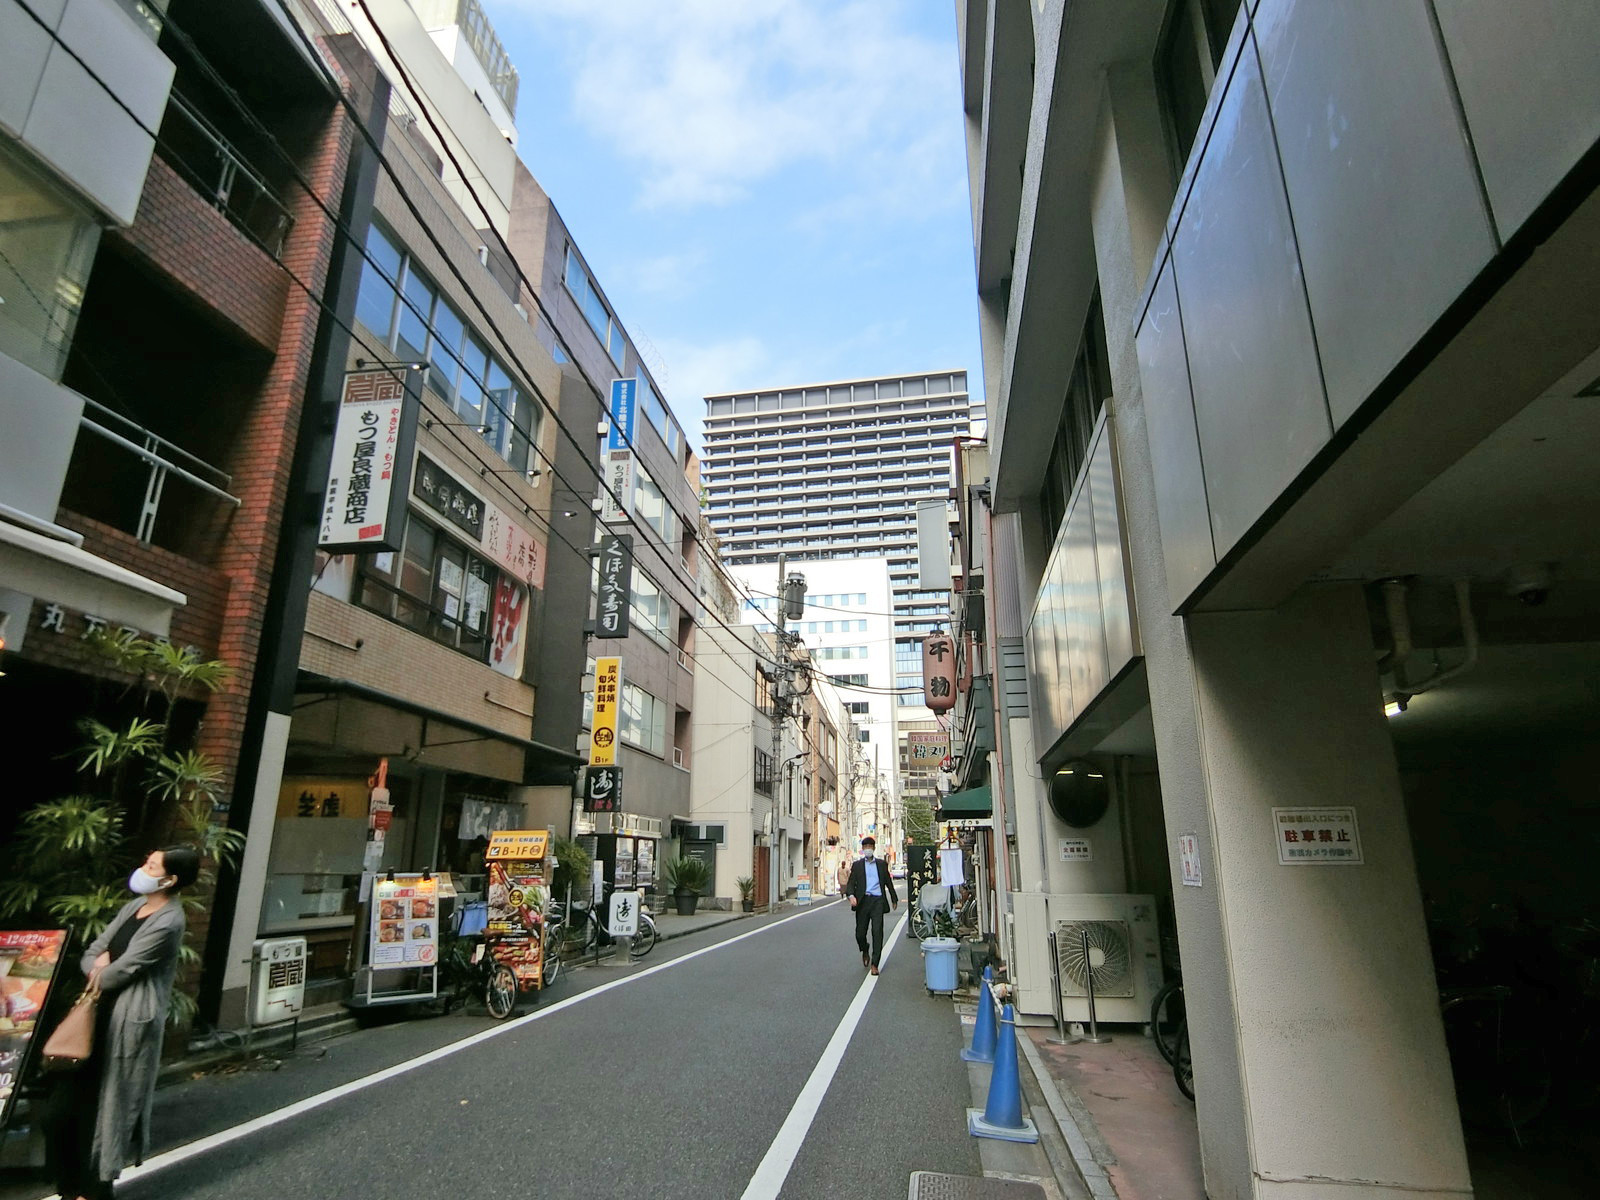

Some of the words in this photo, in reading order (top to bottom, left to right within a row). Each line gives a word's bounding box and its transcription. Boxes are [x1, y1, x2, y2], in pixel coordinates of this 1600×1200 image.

[343, 410, 379, 524] もつ屋良蔵商店
[929, 640, 950, 698] 干物
[1284, 829, 1351, 843] 駐車禁止
